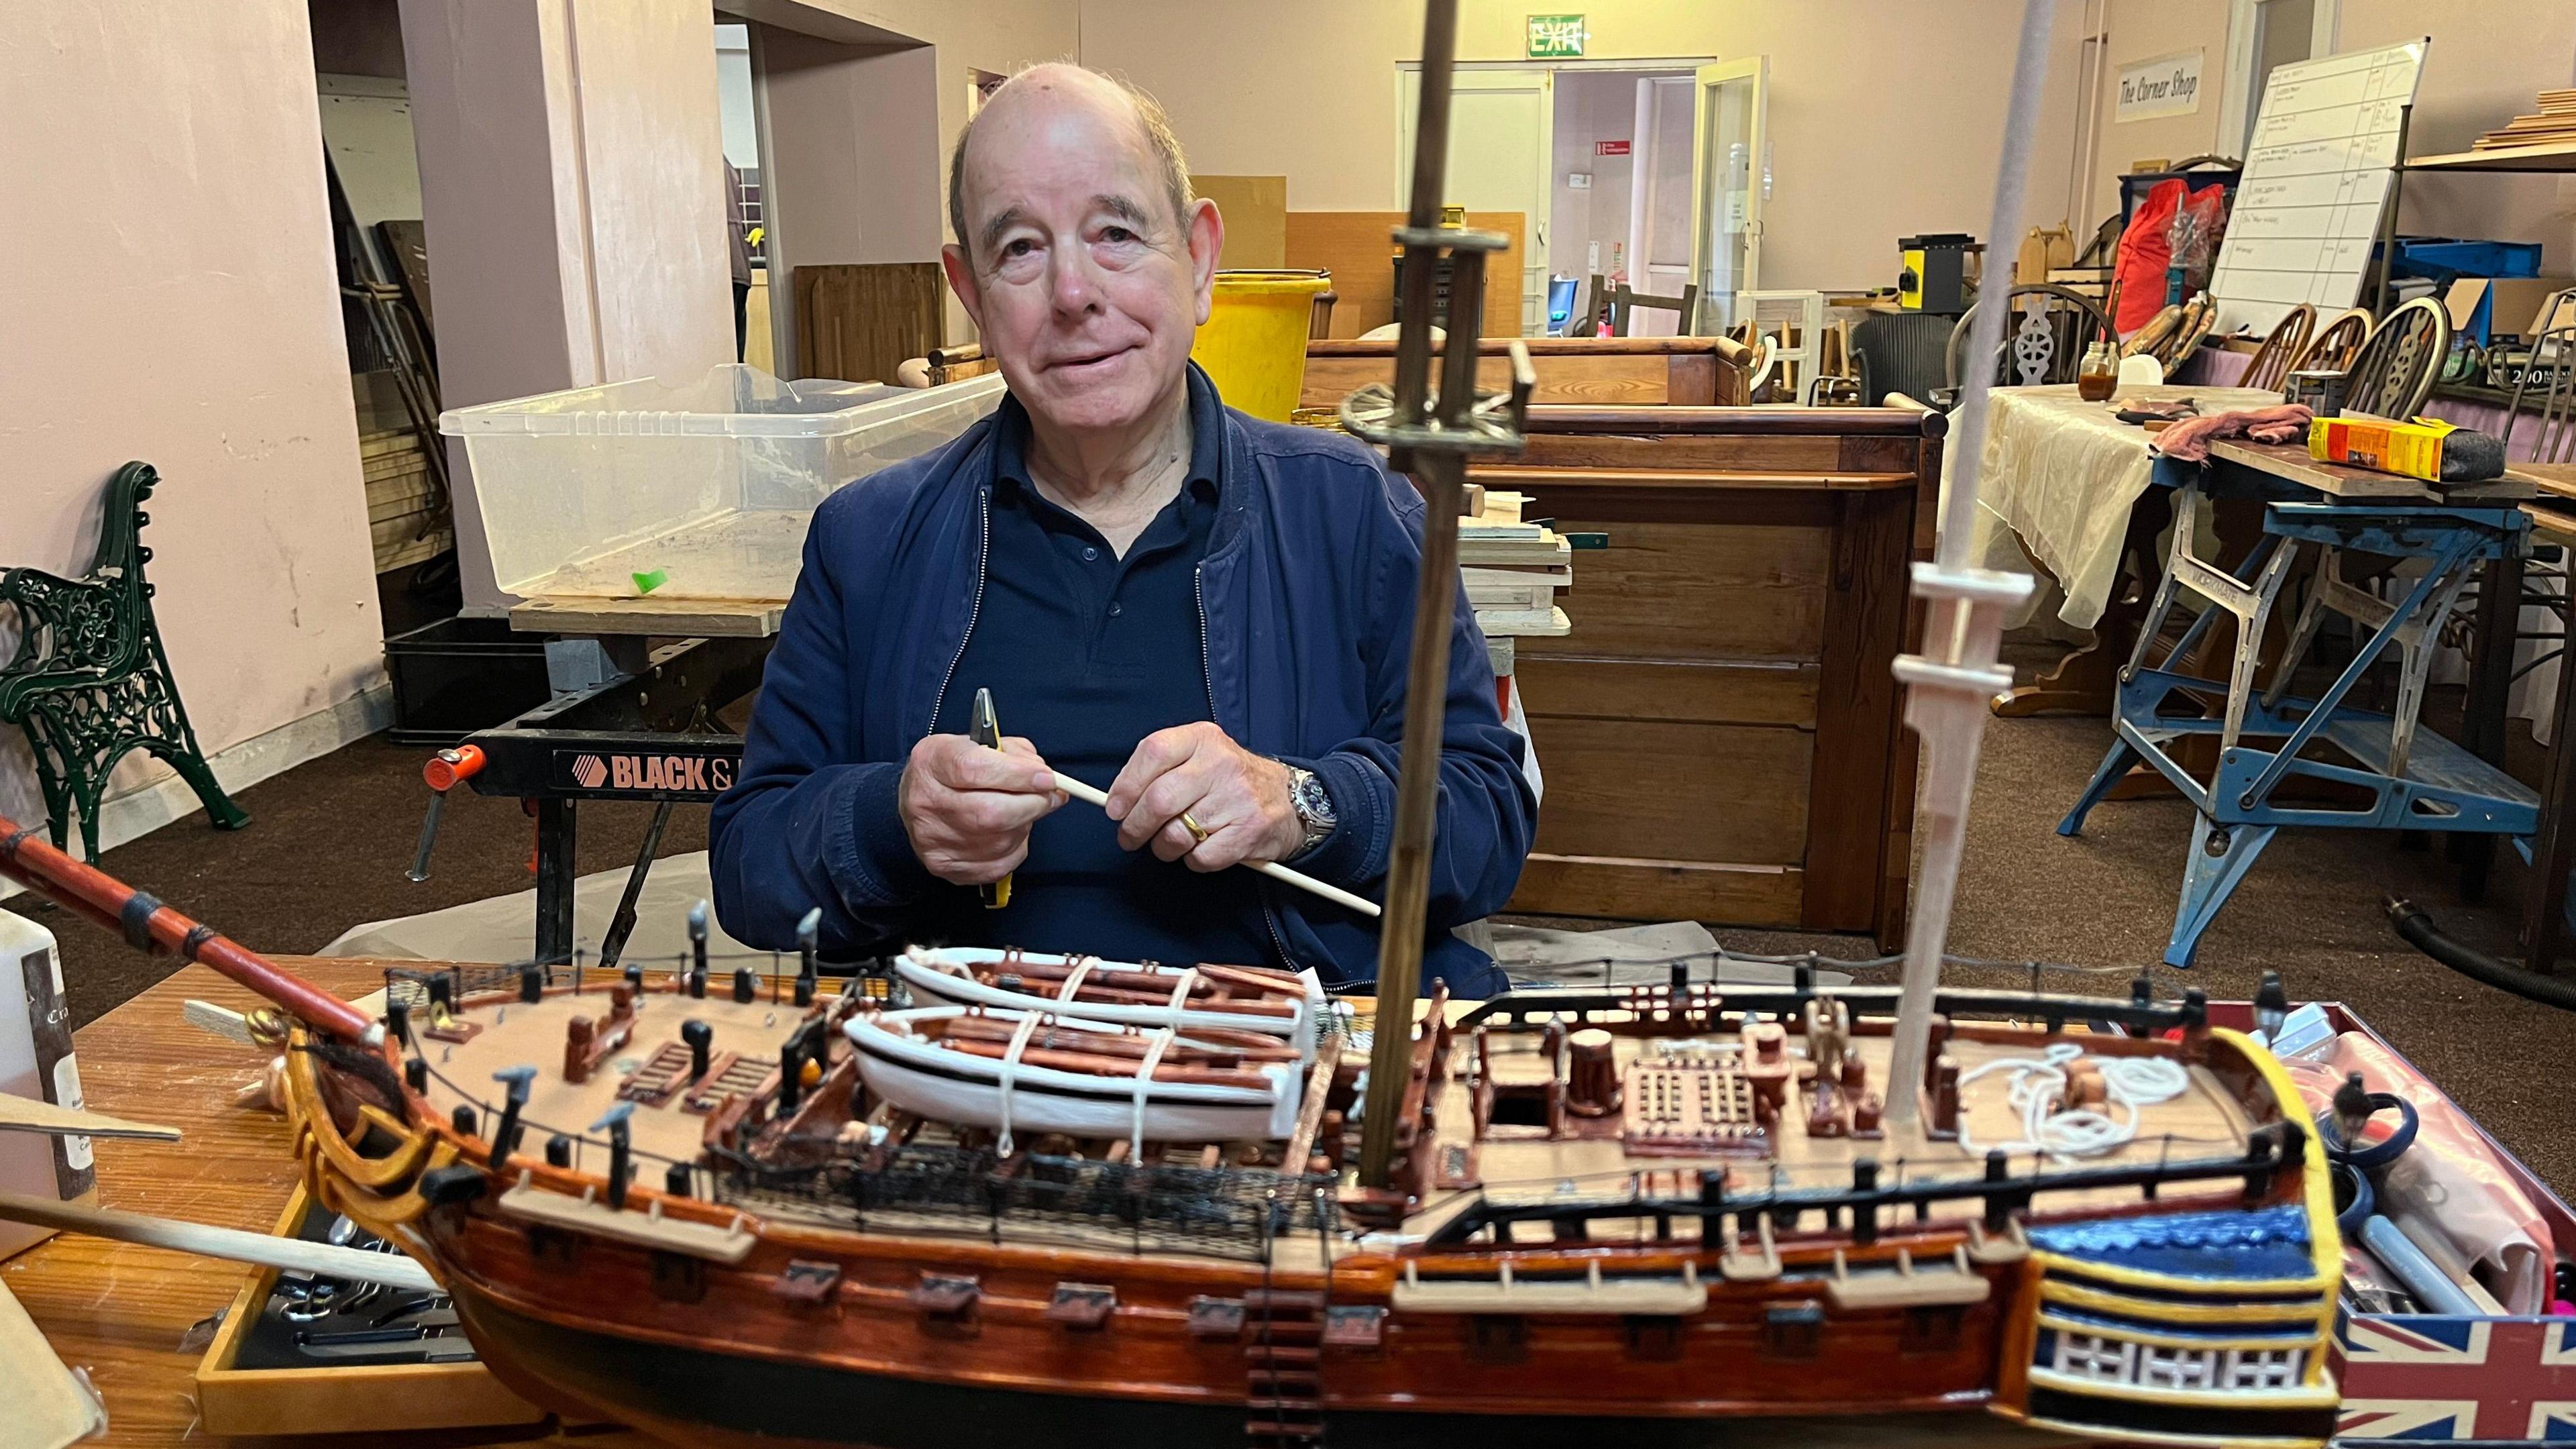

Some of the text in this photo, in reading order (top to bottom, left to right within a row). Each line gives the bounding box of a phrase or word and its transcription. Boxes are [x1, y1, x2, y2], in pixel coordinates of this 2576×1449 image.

[1530, 21, 1582, 52] EXIT
[2120, 68, 2197, 105] The Corner Shop
[611, 755, 733, 791] BLACK &
